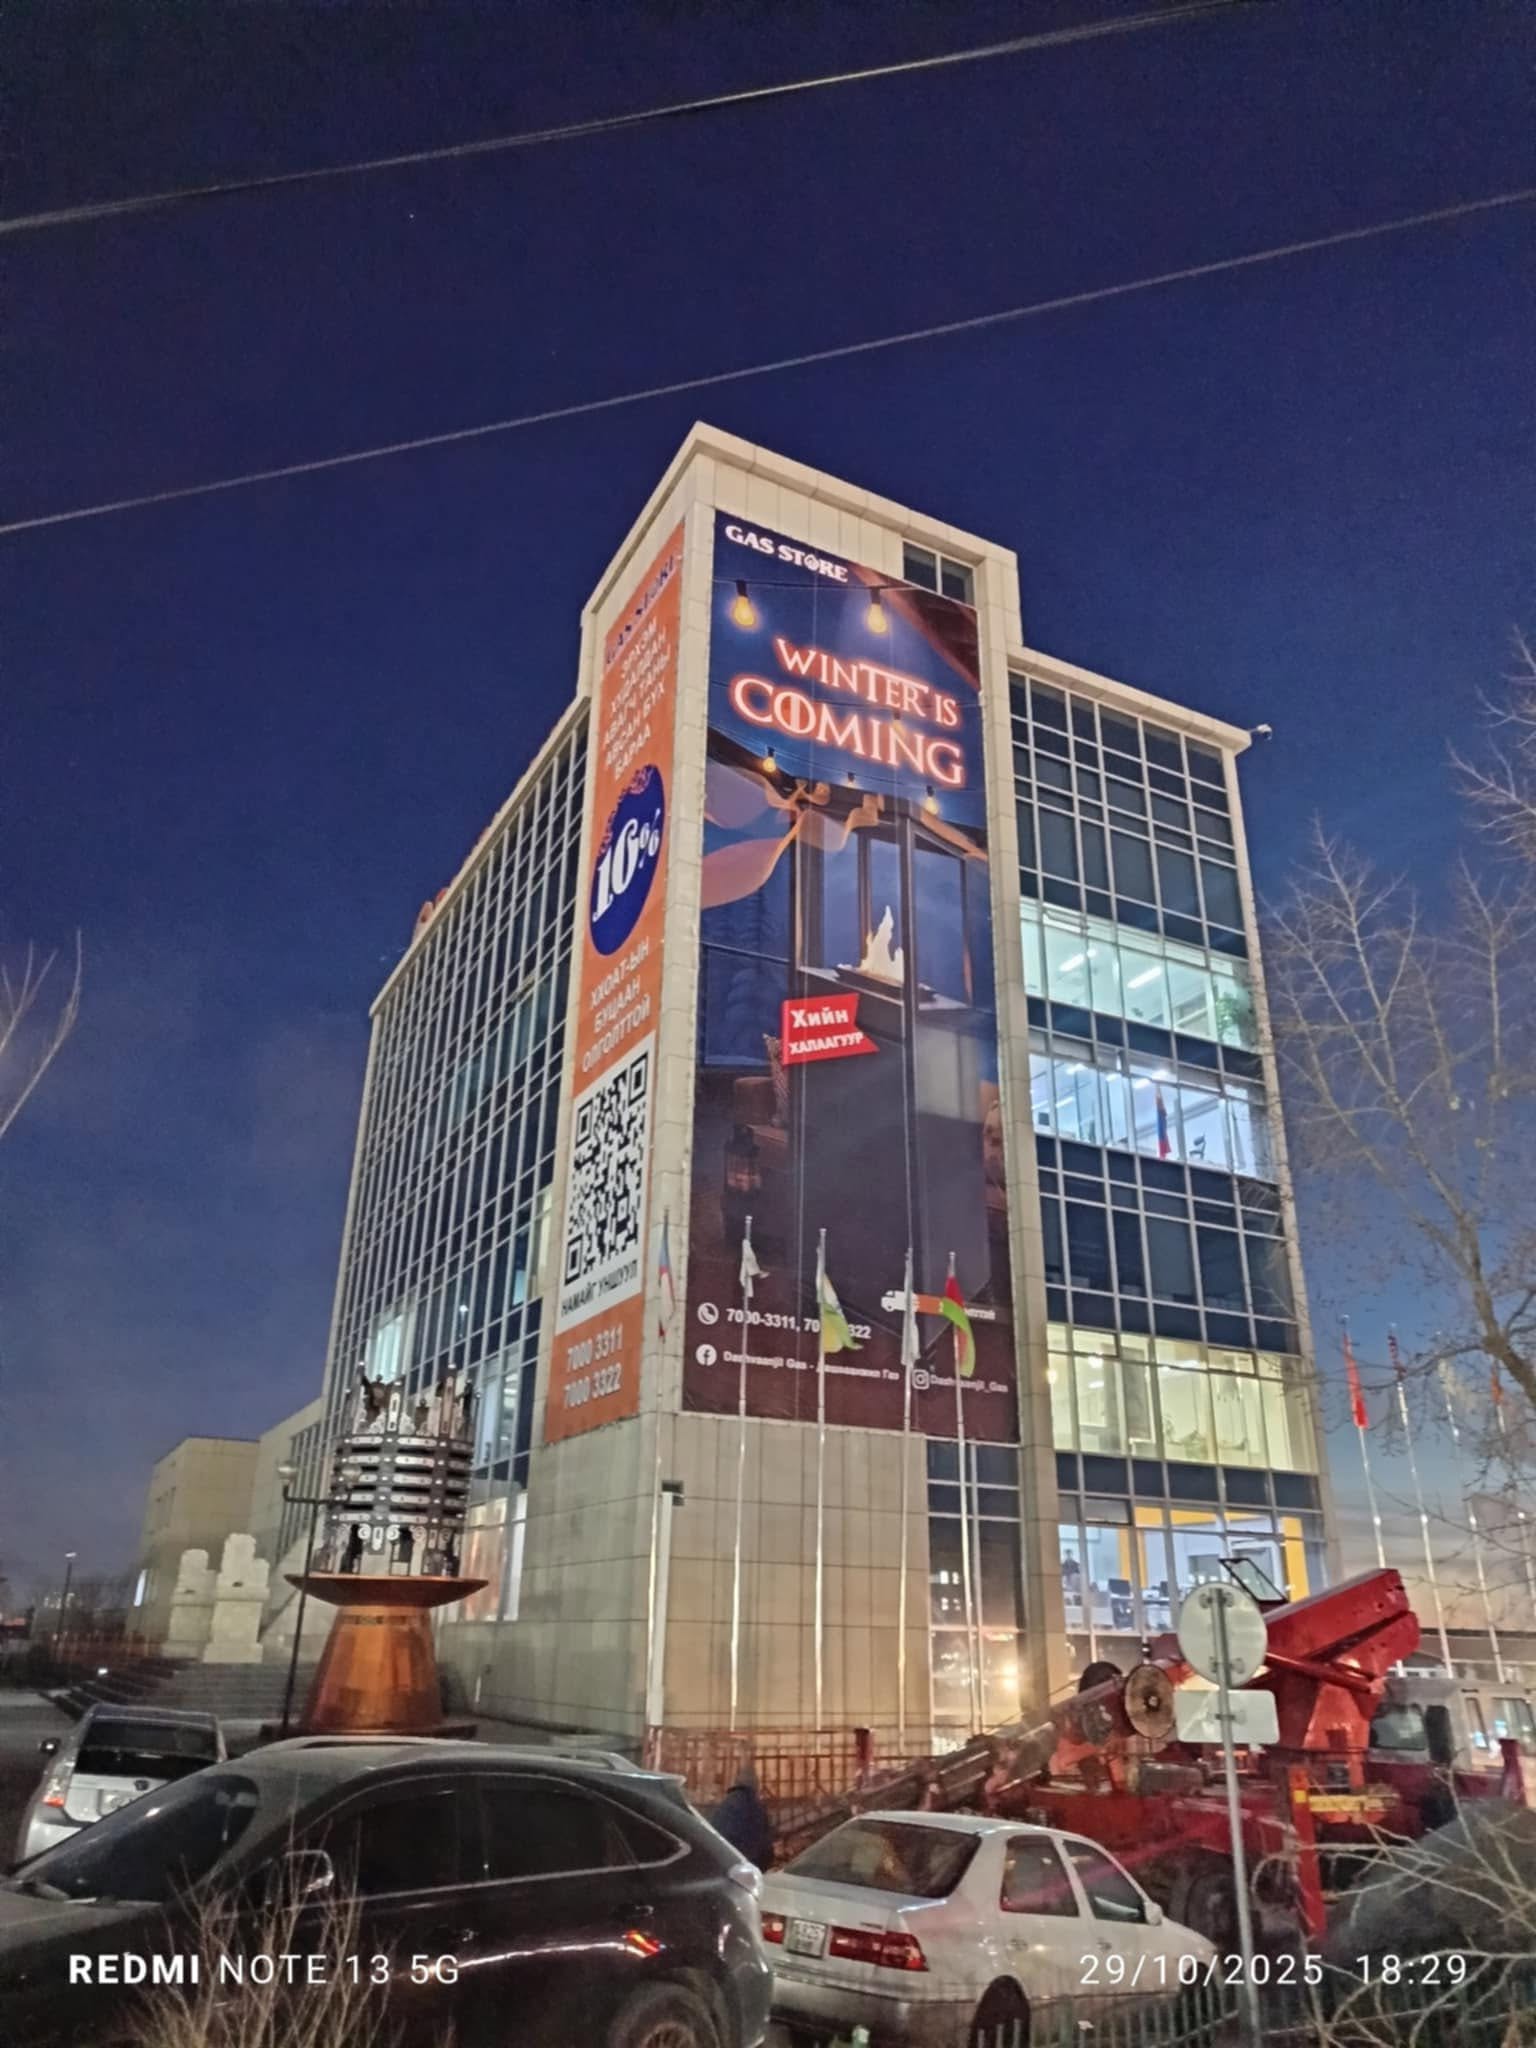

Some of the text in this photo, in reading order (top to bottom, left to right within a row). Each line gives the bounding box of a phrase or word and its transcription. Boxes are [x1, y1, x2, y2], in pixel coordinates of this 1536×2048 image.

[725, 524, 849, 584] GAS STORE
[776, 639, 960, 728] WINTER IS
[733, 676, 965, 785] COMING
[592, 807, 661, 922] 10%
[790, 1006, 849, 1029] Хийн
[595, 1323, 624, 1360] 3311
[592, 1363, 622, 1399] 3322
